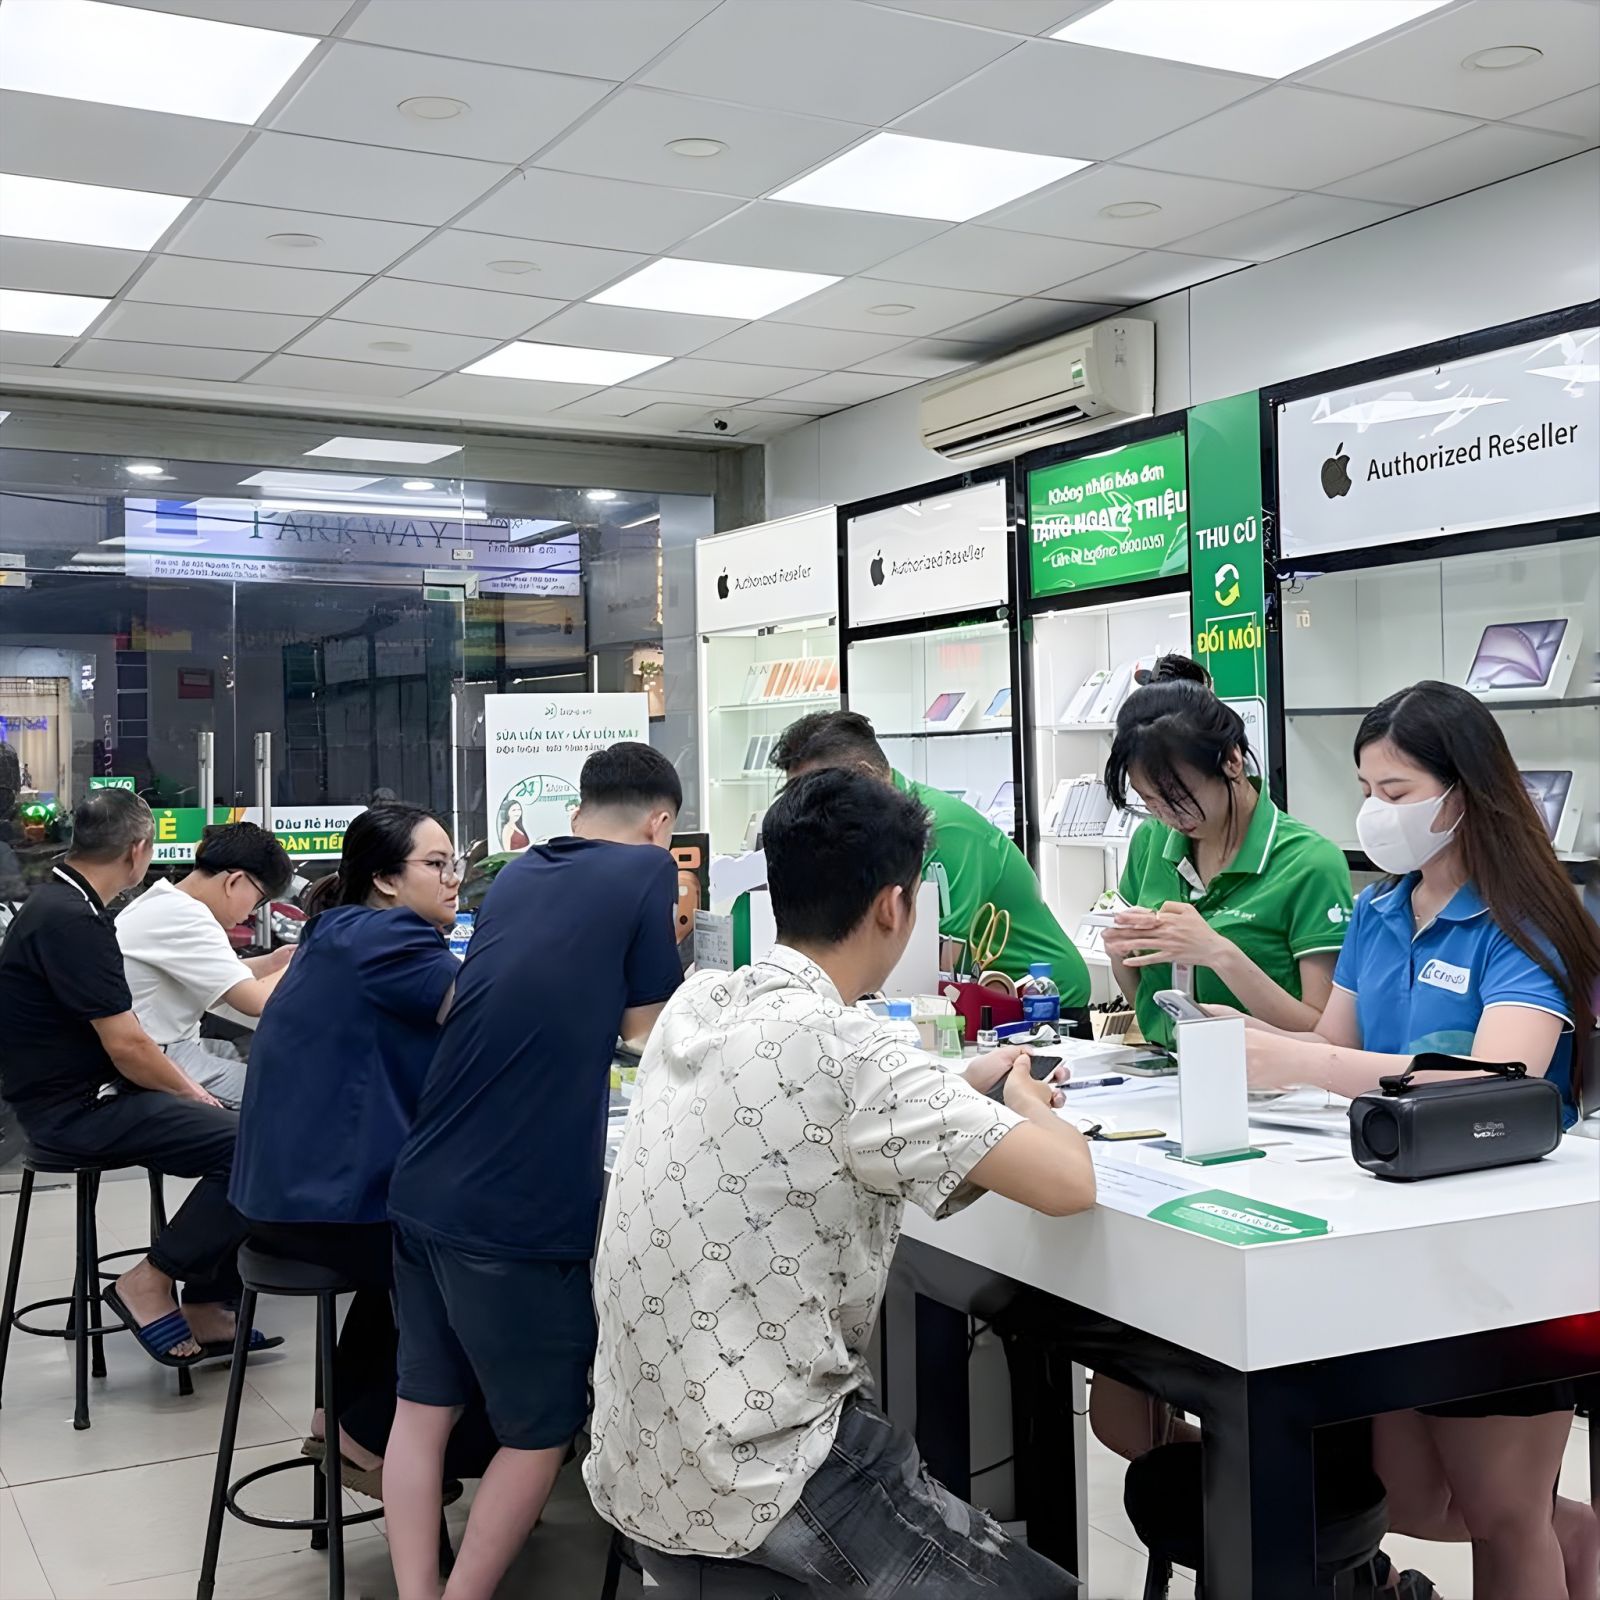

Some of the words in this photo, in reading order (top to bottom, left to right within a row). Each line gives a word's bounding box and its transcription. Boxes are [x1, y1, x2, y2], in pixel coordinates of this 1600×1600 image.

[1367, 437, 1481, 481] Authorized
[1488, 422, 1578, 458] Reseller
[1134, 488, 1187, 521] TRIỆU
[1196, 525, 1229, 550] THU
[1233, 516, 1256, 544] CŨ
